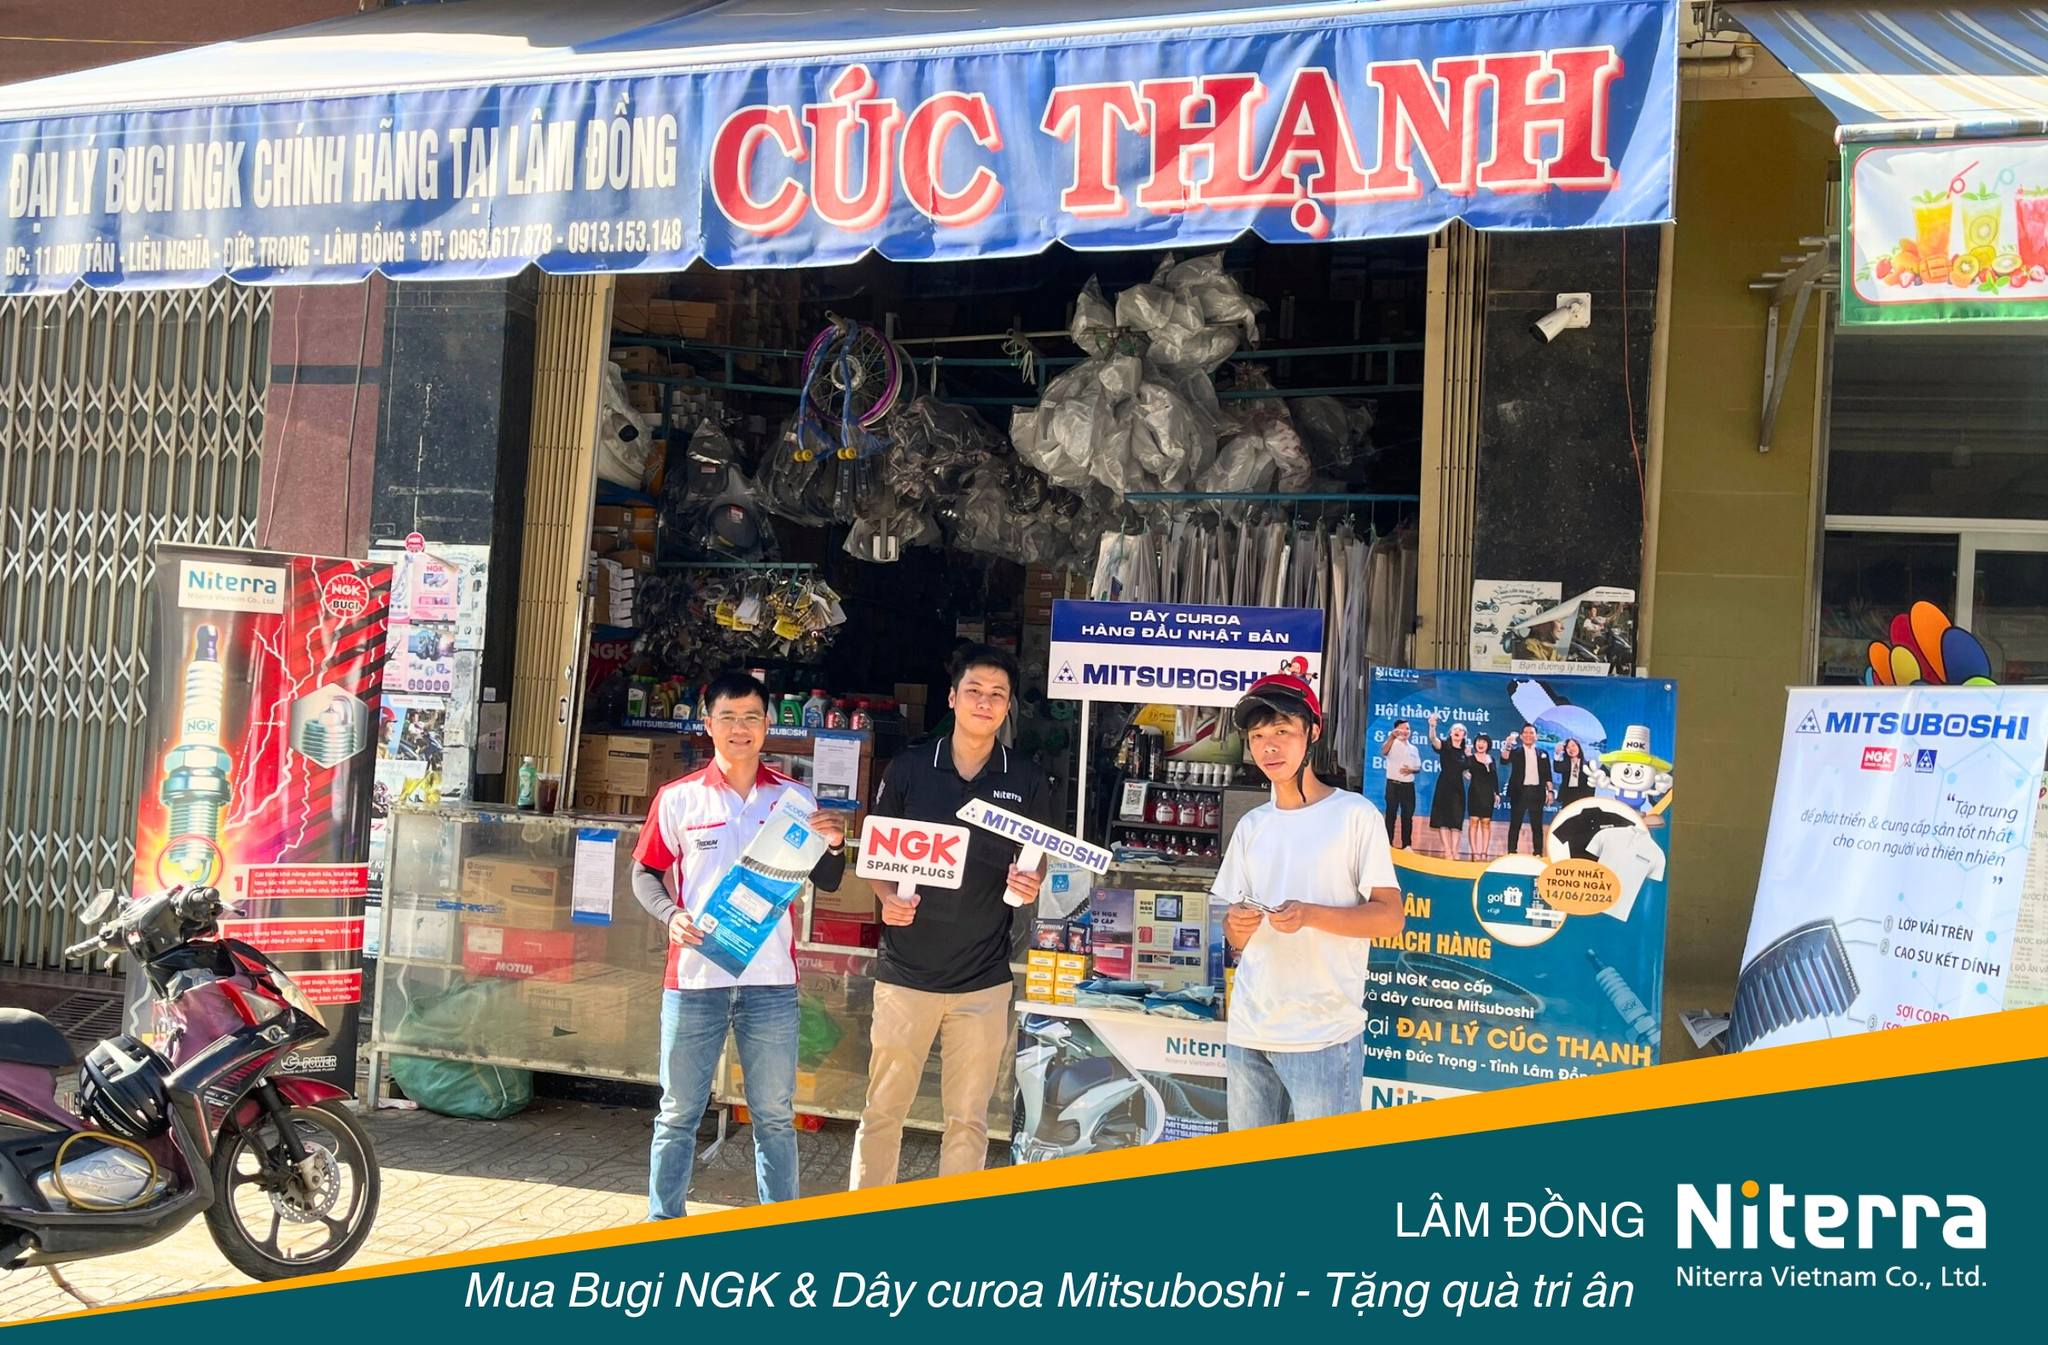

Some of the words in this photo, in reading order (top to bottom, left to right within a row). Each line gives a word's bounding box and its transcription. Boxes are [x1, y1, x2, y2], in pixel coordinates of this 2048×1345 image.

[710, 65, 1004, 237] CÚC
[1040, 45, 1624, 237] THẠNH
[9, 151, 59, 233] ĐẠI
[65, 135, 99, 216] LÝ
[105, 144, 175, 214] BUGI
[182, 141, 246, 211] NGK
[253, 122, 346, 208] CHÍNH
[353, 117, 439, 203] HÃNG
[448, 127, 499, 214] TẠI
[507, 107, 576, 196] LÂM
[586, 92, 678, 191] ĐỒNG
[6, 246, 31, 276] ĐC:
[35, 246, 50, 275] 11
[55, 242, 82, 274] DUY
[85, 235, 116, 273] TÂN
[128, 234, 161, 272] LIÊN
[165, 233, 211, 272] NGHĨA
[223, 230, 255, 268] ĐỨC
[260, 234, 310, 274] TRỌNG
[323, 227, 357, 265] LÂM
[361, 221, 405, 264] ĐỒNG
[421, 231, 444, 262] ĐT:
[448, 222, 552, 261] 0963.617.878
[568, 218, 682, 254] 0913.153.148
[188, 569, 277, 594] Niterra
[331, 584, 361, 597] NGK
[1130, 610, 1169, 623] DÂY
[1175, 613, 1241, 626] CUROA
[1081, 622, 1135, 638] HÀNG
[1142, 623, 1182, 640] ĐẦU
[1188, 628, 1242, 644] NHẬT
[1248, 628, 1289, 644] BẢN
[1375, 666, 1419, 678] Niterra
[1519, 662, 1537, 672] Bạn
[1374, 704, 1398, 720] Hội
[1401, 705, 1431, 718] thảo
[1453, 708, 1490, 725] thuật
[187, 719, 216, 733] NGK
[1825, 712, 2030, 740] MITSUBOSHI
[1374, 730, 1384, 742] &
[1626, 741, 1646, 750] NGK
[1864, 751, 1893, 763] NGK
[993, 789, 1022, 803] Niterra
[1979, 805, 2018, 824] trung
[1812, 810, 1839, 826] phát
[1869, 816, 1879, 829] &
[1881, 818, 1909, 836] cung
[1910, 817, 1931, 837] cấp
[1957, 821, 1977, 839] tốt
[1978, 823, 2013, 844] nhất
[868, 825, 961, 866] NGK
[982, 809, 1108, 870] MITSUBOSHI
[1833, 834, 1855, 848] cho
[1857, 839, 1881, 851] con
[1882, 840, 1914, 858] người
[1916, 843, 1930, 857] và
[1931, 844, 1963, 862] thiên
[1965, 849, 2005, 868] nhiên
[866, 860, 908, 874] SPARK
[911, 865, 955, 879] PLUGS
[1555, 868, 1574, 877] DUY
[1578, 867, 1605, 879] NHẤT
[234, 876, 243, 892] 1
[1547, 879, 1580, 890] TRONG
[1583, 879, 1612, 891] NGÀY
[1404, 893, 1431, 918] ÂN
[1487, 893, 1503, 903] got
[1546, 889, 1612, 903] 14/06/2024
[1898, 916, 1917, 931] LỚP
[1920, 919, 1938, 935] VẢI
[1941, 925, 1974, 942] TRÊN
[1437, 931, 1491, 959] HÀNG
[496, 962, 534, 975] MOTUL
[1894, 945, 1915, 960] CAO
[1917, 949, 1933, 963] SU
[1935, 951, 1959, 968] KẾT
[1961, 957, 2001, 977] DÍNH
[1396, 972, 1428, 987] NGK
[1432, 979, 1460, 990] cao
[1464, 979, 1493, 995] cấp
[1381, 991, 1408, 1007] dây
[1411, 996, 1453, 1009] curoa
[1457, 1000, 1534, 1019] Mitsuboshi
[1621, 999, 1639, 1013] NGK
[1896, 1004, 1913, 1022] SỢI
[1397, 1017, 1442, 1045] ĐẠI
[1451, 1020, 1479, 1046] LÝ
[1487, 1026, 1548, 1054] CÚC
[1556, 1035, 1651, 1067] THẠNH
[1405, 1049, 1434, 1064] Đức
[1437, 1053, 1477, 1071] Trọng
[1489, 1059, 1518, 1075] Tỉnh
[1523, 1064, 1553, 1079] Lâm
[1166, 1120, 1218, 1132] MITSUBOSHI
